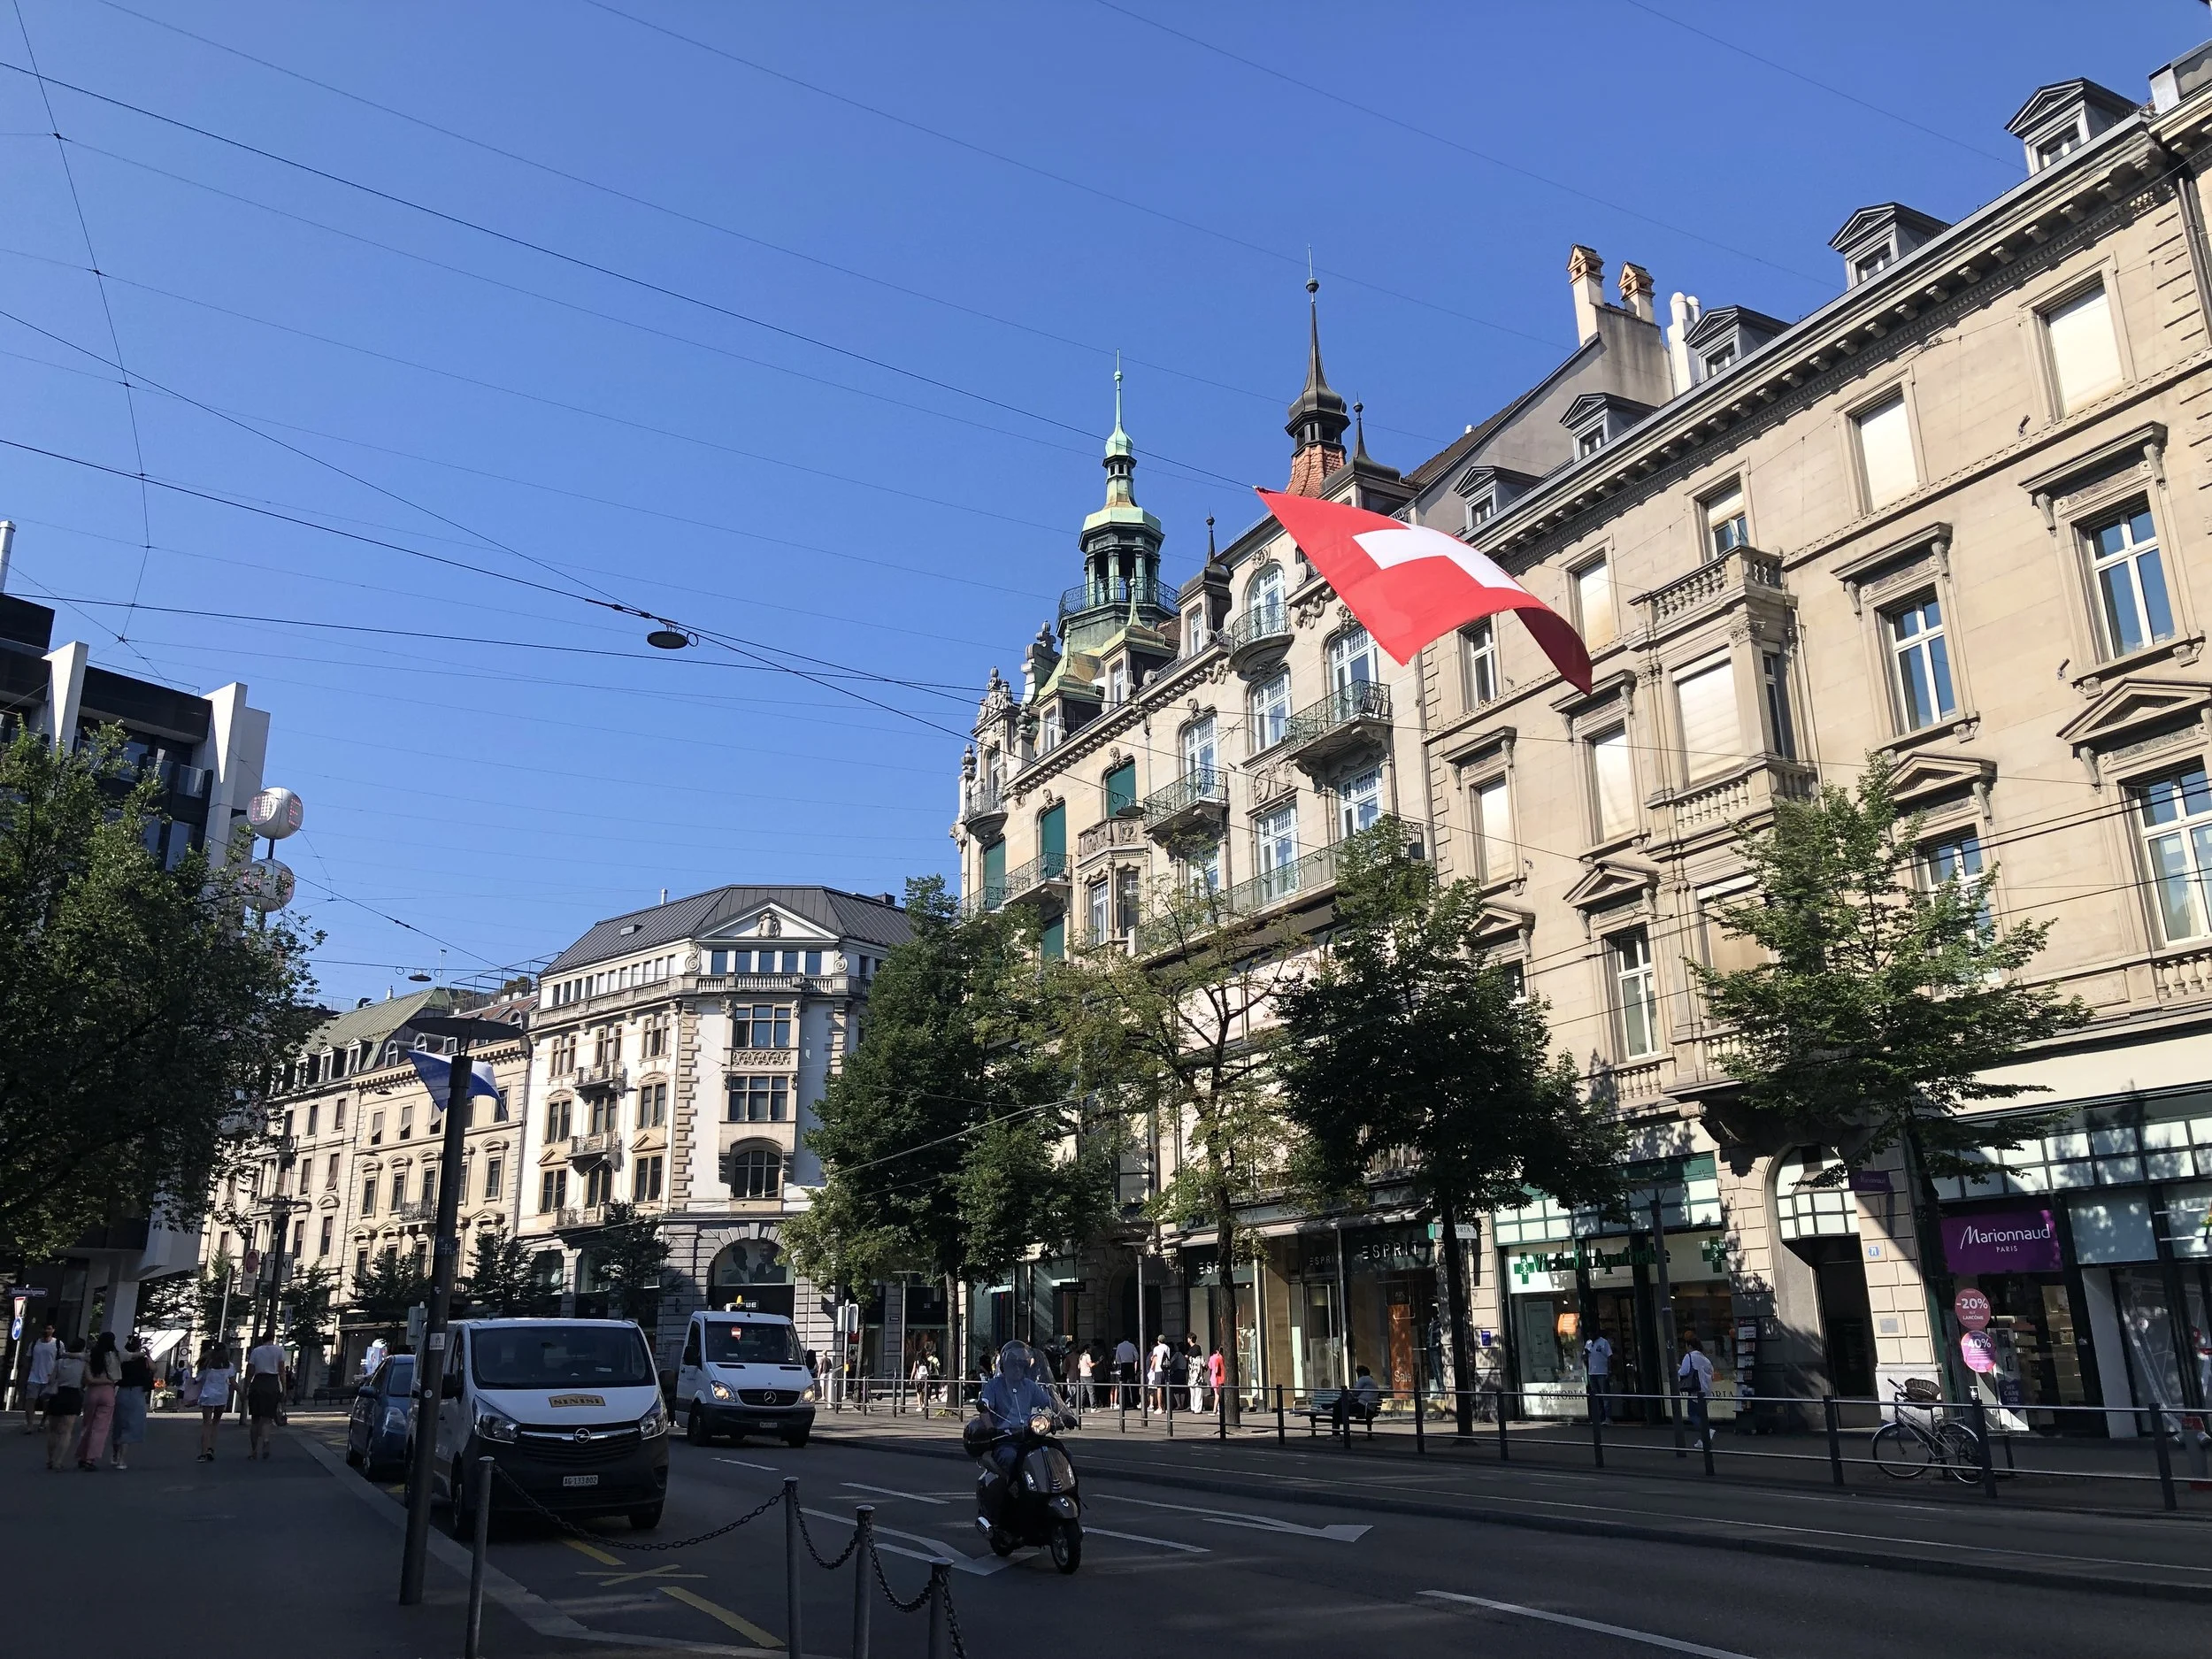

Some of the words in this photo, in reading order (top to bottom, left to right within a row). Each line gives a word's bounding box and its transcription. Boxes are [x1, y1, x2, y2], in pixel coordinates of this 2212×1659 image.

[1960, 1225, 2051, 1250] Marionnaud
[1362, 1241, 1419, 1260] ESPRIT
[269, 1260, 291, 1269] TXI
[1956, 1298, 1988, 1310] -20%
[1963, 1339, 1992, 1348] -40%
[1394, 1371, 1412, 1383] Sale
